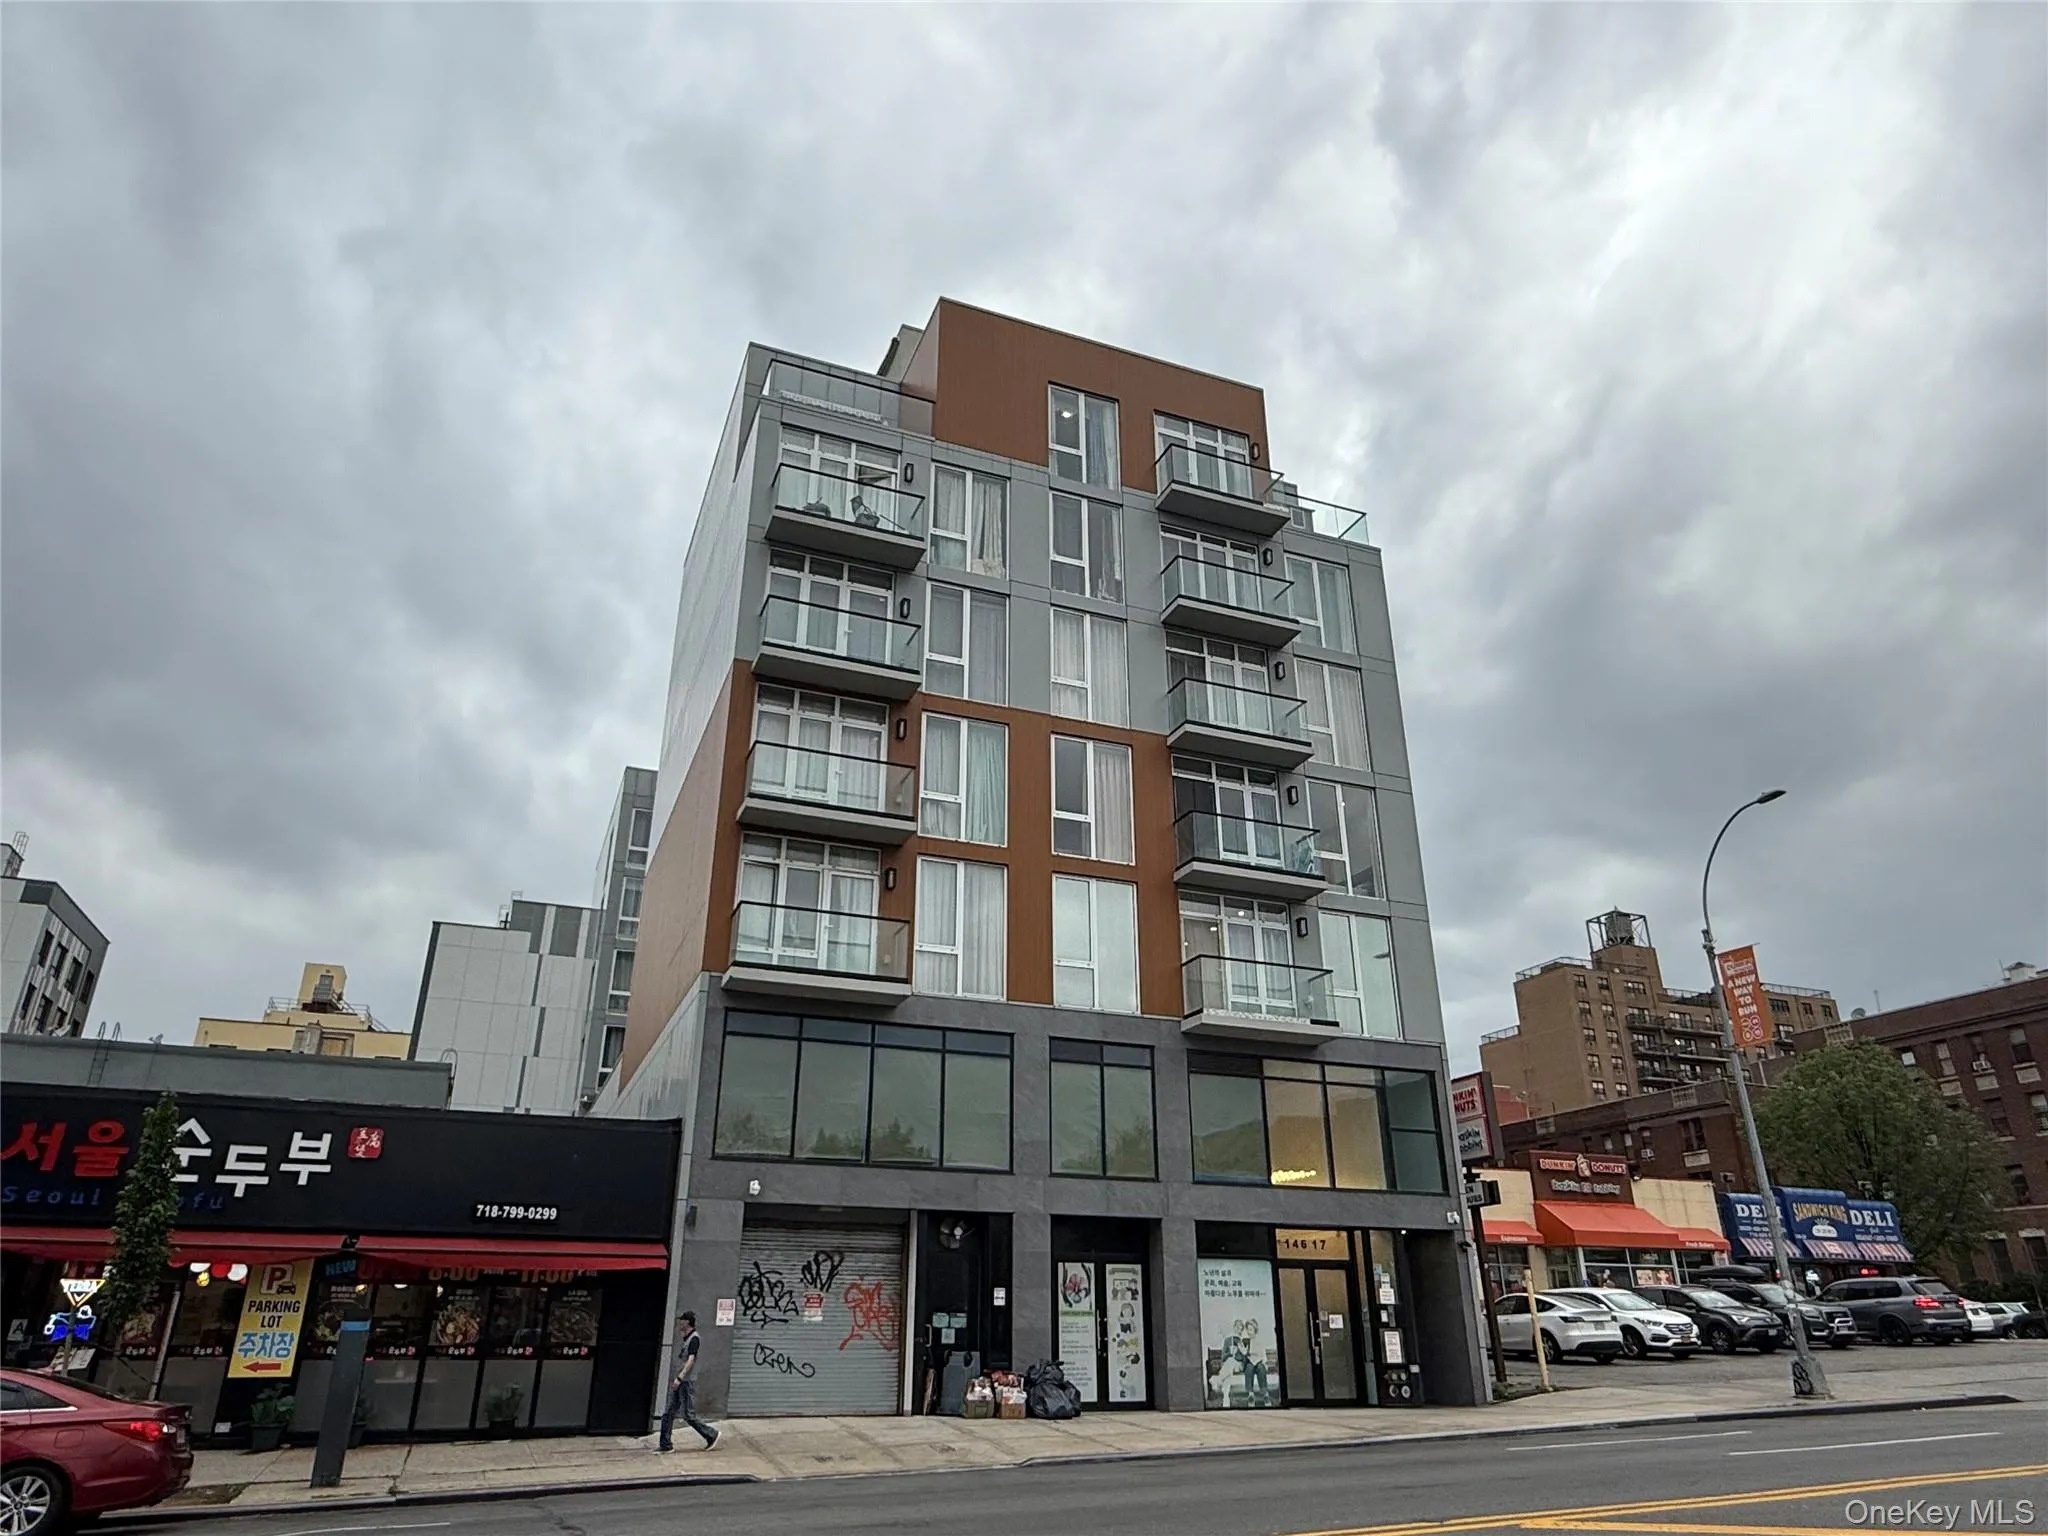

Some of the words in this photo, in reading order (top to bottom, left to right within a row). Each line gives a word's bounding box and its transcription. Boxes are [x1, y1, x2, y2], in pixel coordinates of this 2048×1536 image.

[1734, 974, 1756, 985] NEW
[1735, 985, 1752, 997] WAY
[1739, 996, 1752, 1005] TO
[1738, 1006, 1758, 1017] RUN
[1452, 1087, 1477, 1101] NKIN'
[1454, 1101, 1477, 1112] NUTS
[1, 1119, 130, 1178] 서울
[168, 1116, 332, 1198] 순두부
[1591, 1162, 1626, 1174] DONUTS
[172, 1190, 225, 1211] ofu
[475, 1204, 558, 1219] 718-799-0299
[1849, 1209, 1895, 1226] DELI
[248, 1300, 301, 1313] PARKING
[260, 1315, 283, 1328] LOT
[238, 1332, 295, 1358] 주차장
